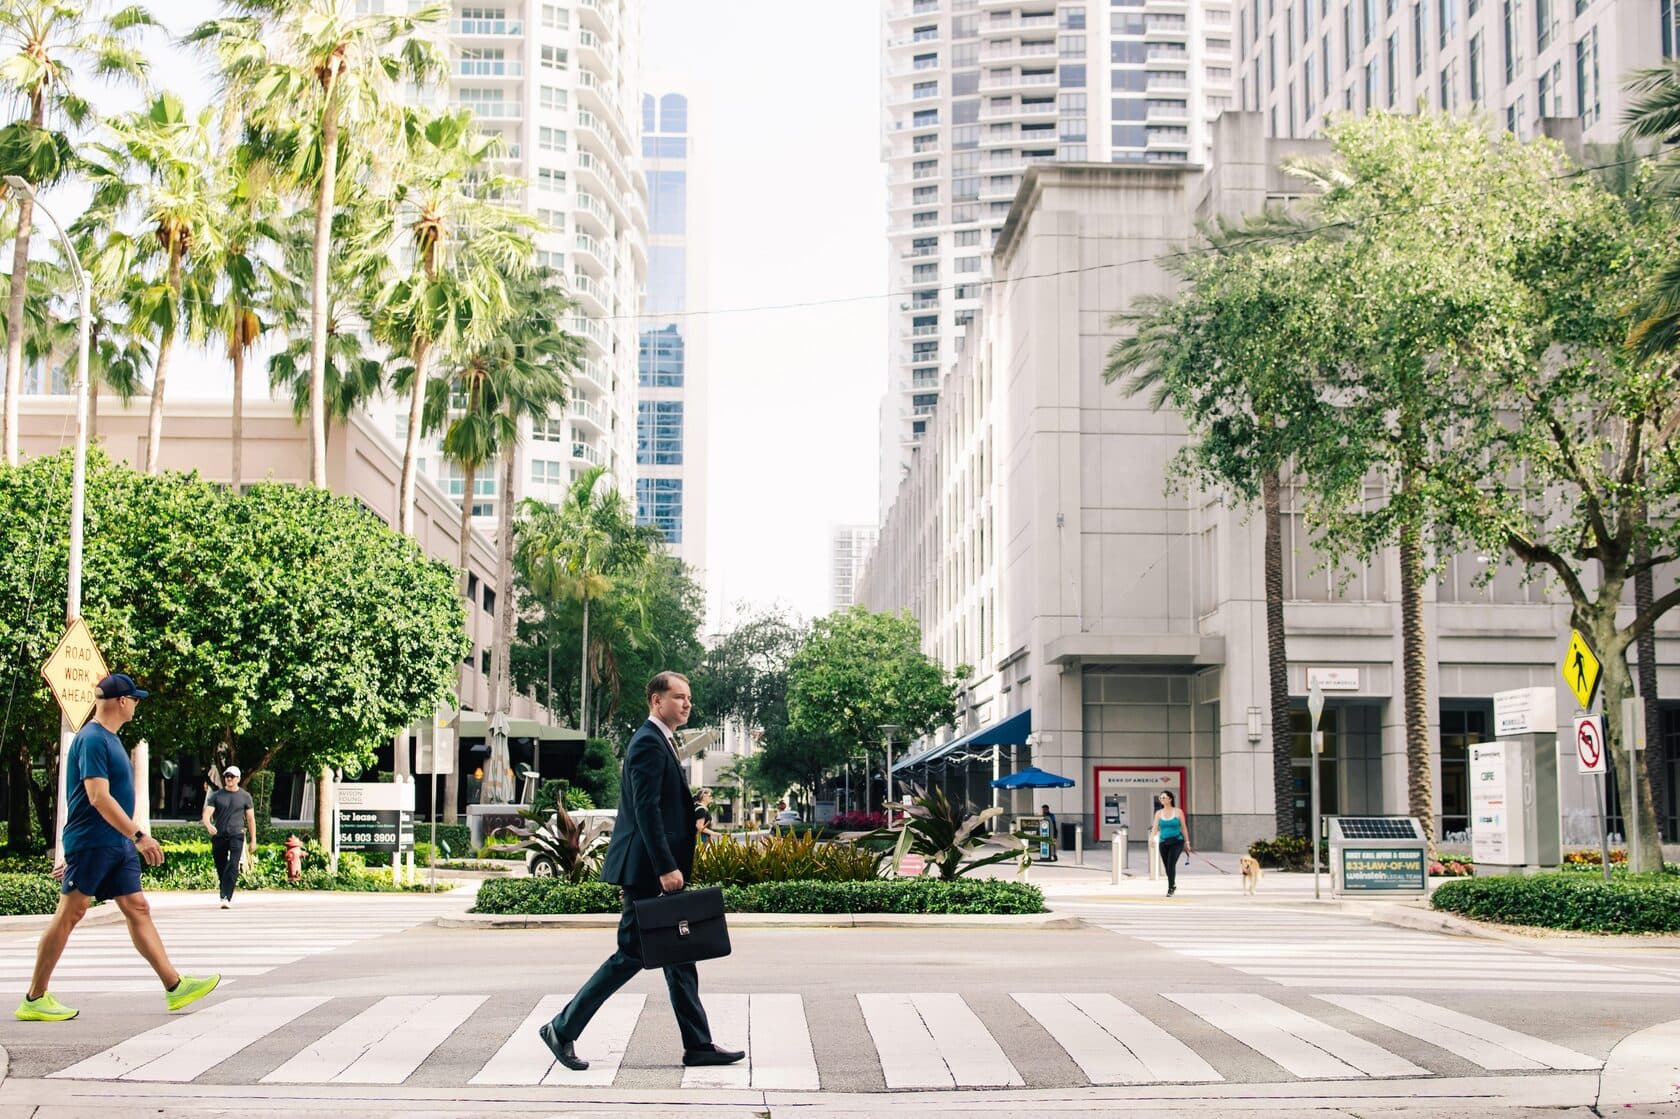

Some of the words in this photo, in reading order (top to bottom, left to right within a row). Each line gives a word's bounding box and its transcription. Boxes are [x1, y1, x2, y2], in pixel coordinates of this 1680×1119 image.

[65, 645, 92, 661] ROAD
[65, 666, 90, 682] WORK
[61, 688, 94, 704] AHEAD
[352, 812, 377, 821] lease
[354, 833, 371, 842] 903
[374, 833, 396, 842] 3900
